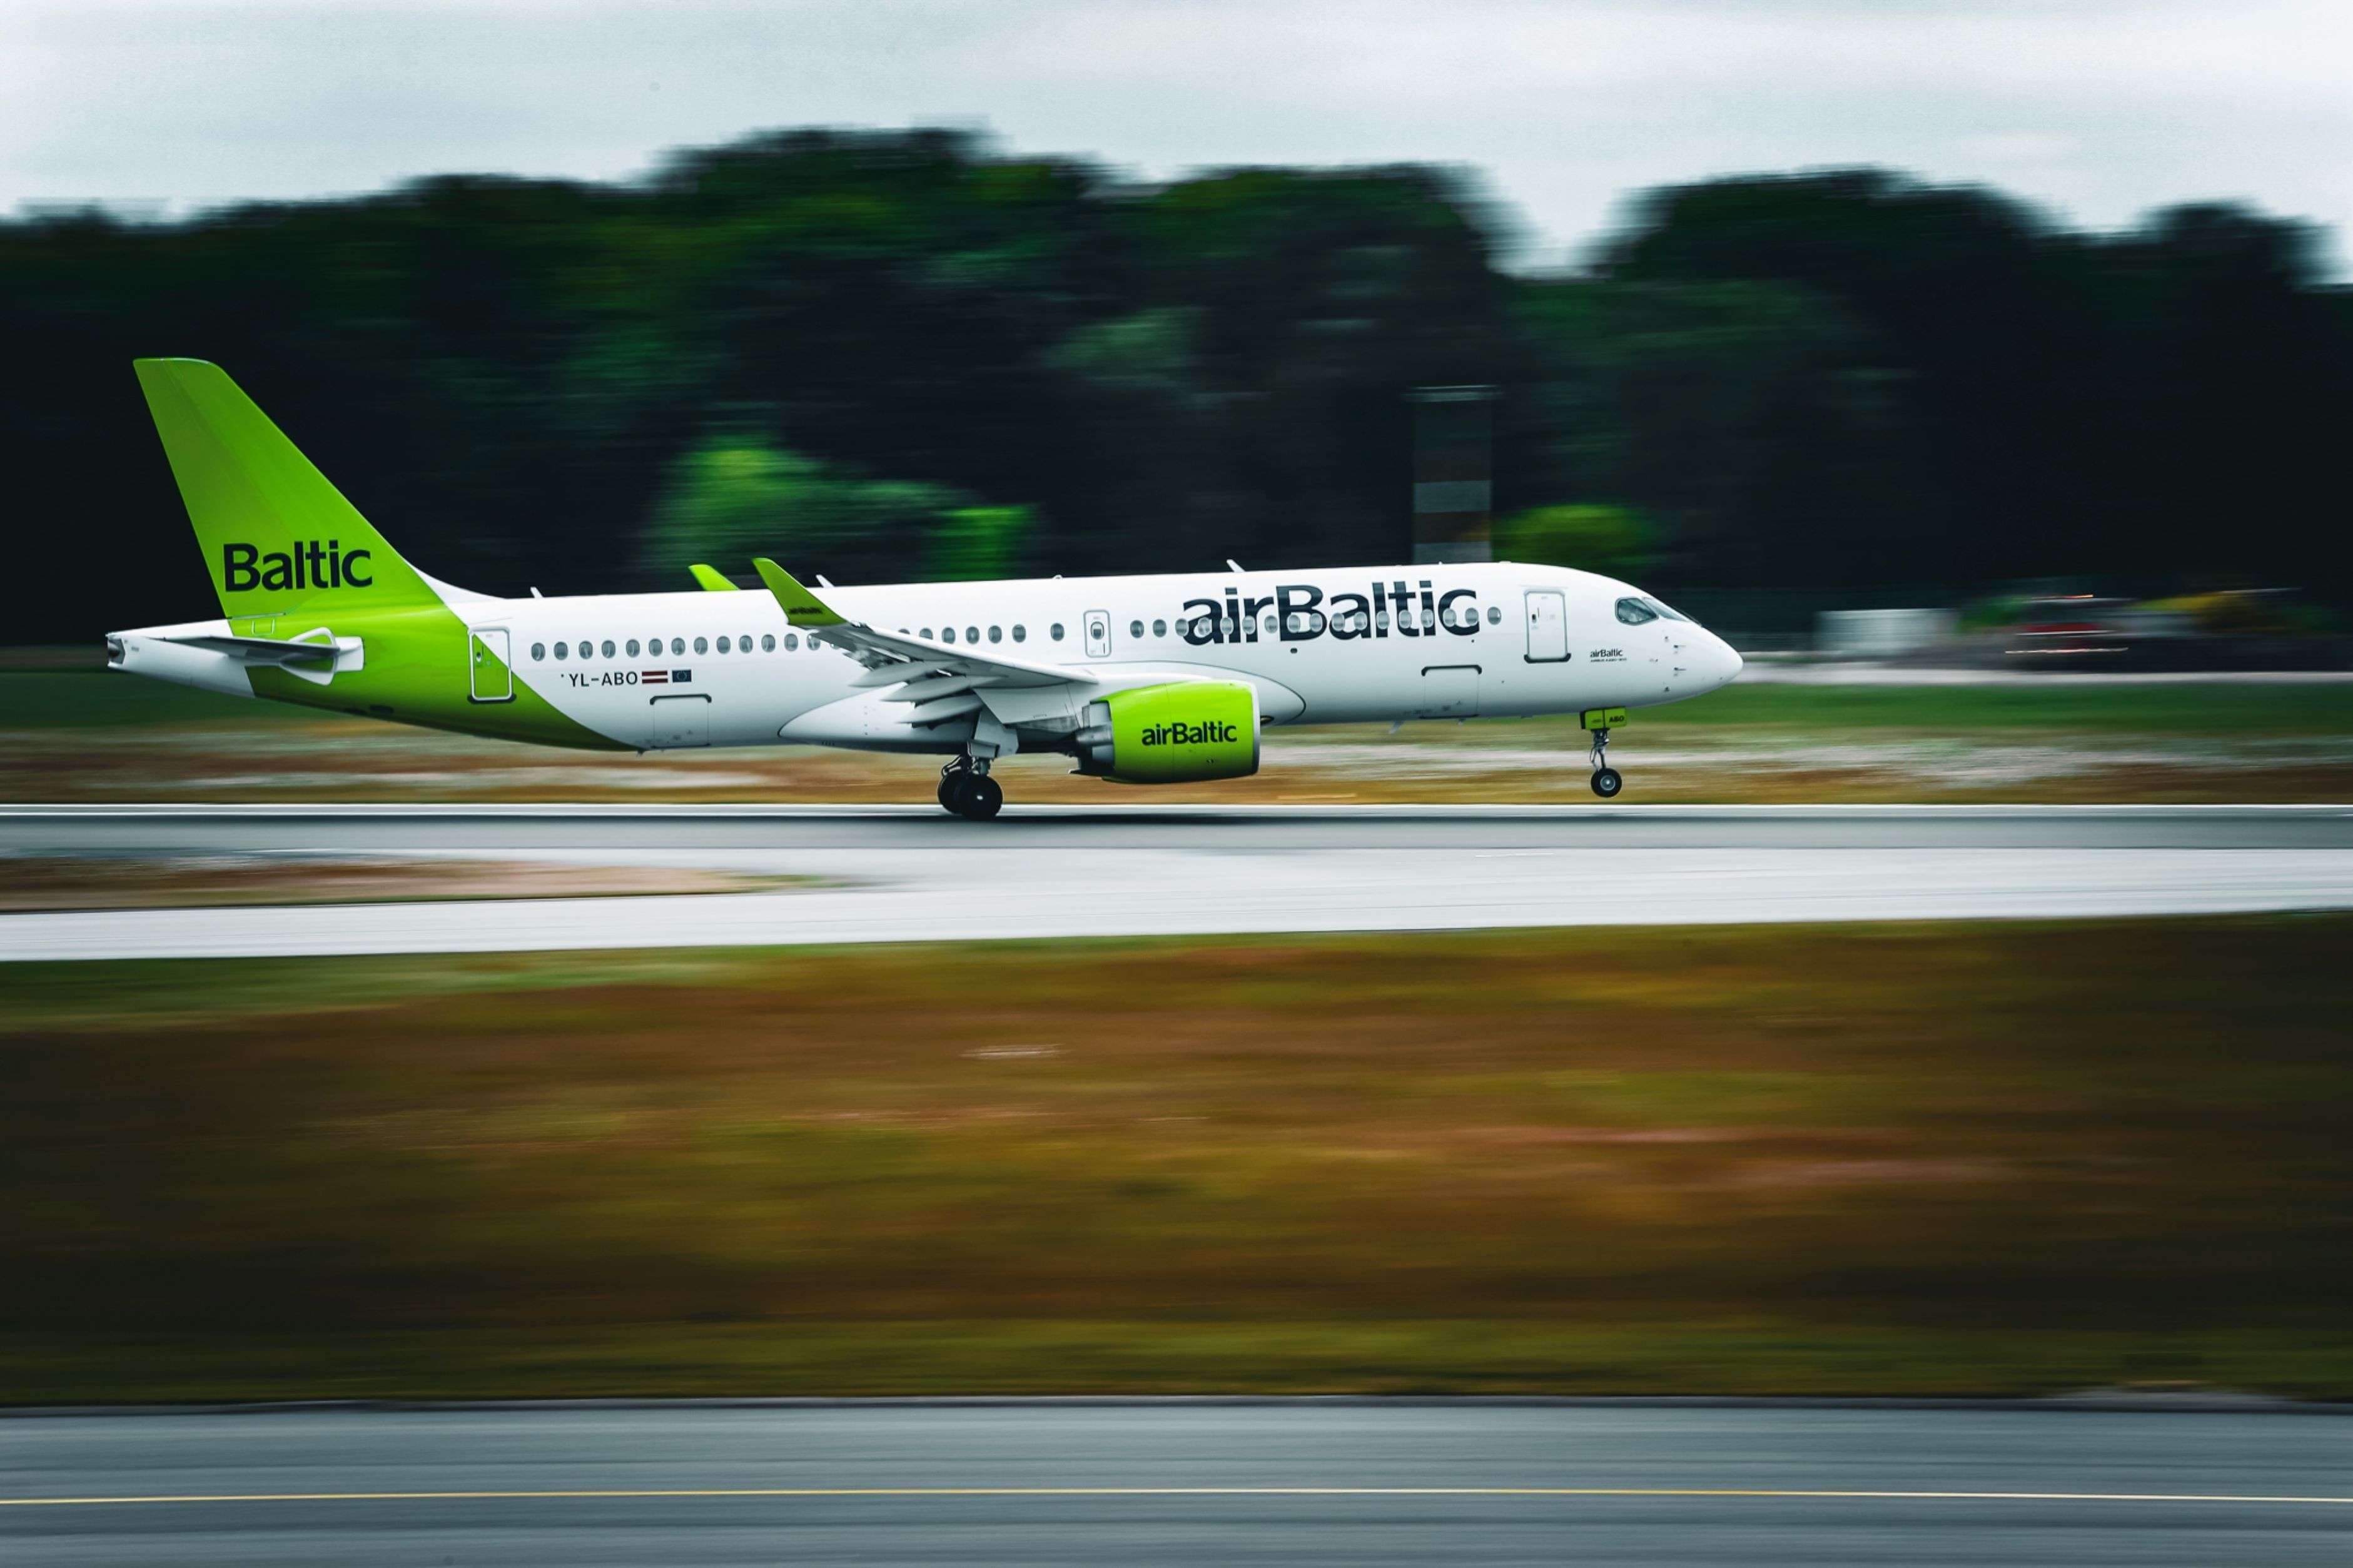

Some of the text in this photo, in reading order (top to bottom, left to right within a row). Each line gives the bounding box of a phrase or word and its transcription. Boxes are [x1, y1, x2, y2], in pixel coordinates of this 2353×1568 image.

[223, 540, 372, 592] Baltic
[1182, 580, 1480, 645] airBaltic
[569, 671, 638, 687] YL-ABO
[1141, 721, 1237, 746] airBaltic
